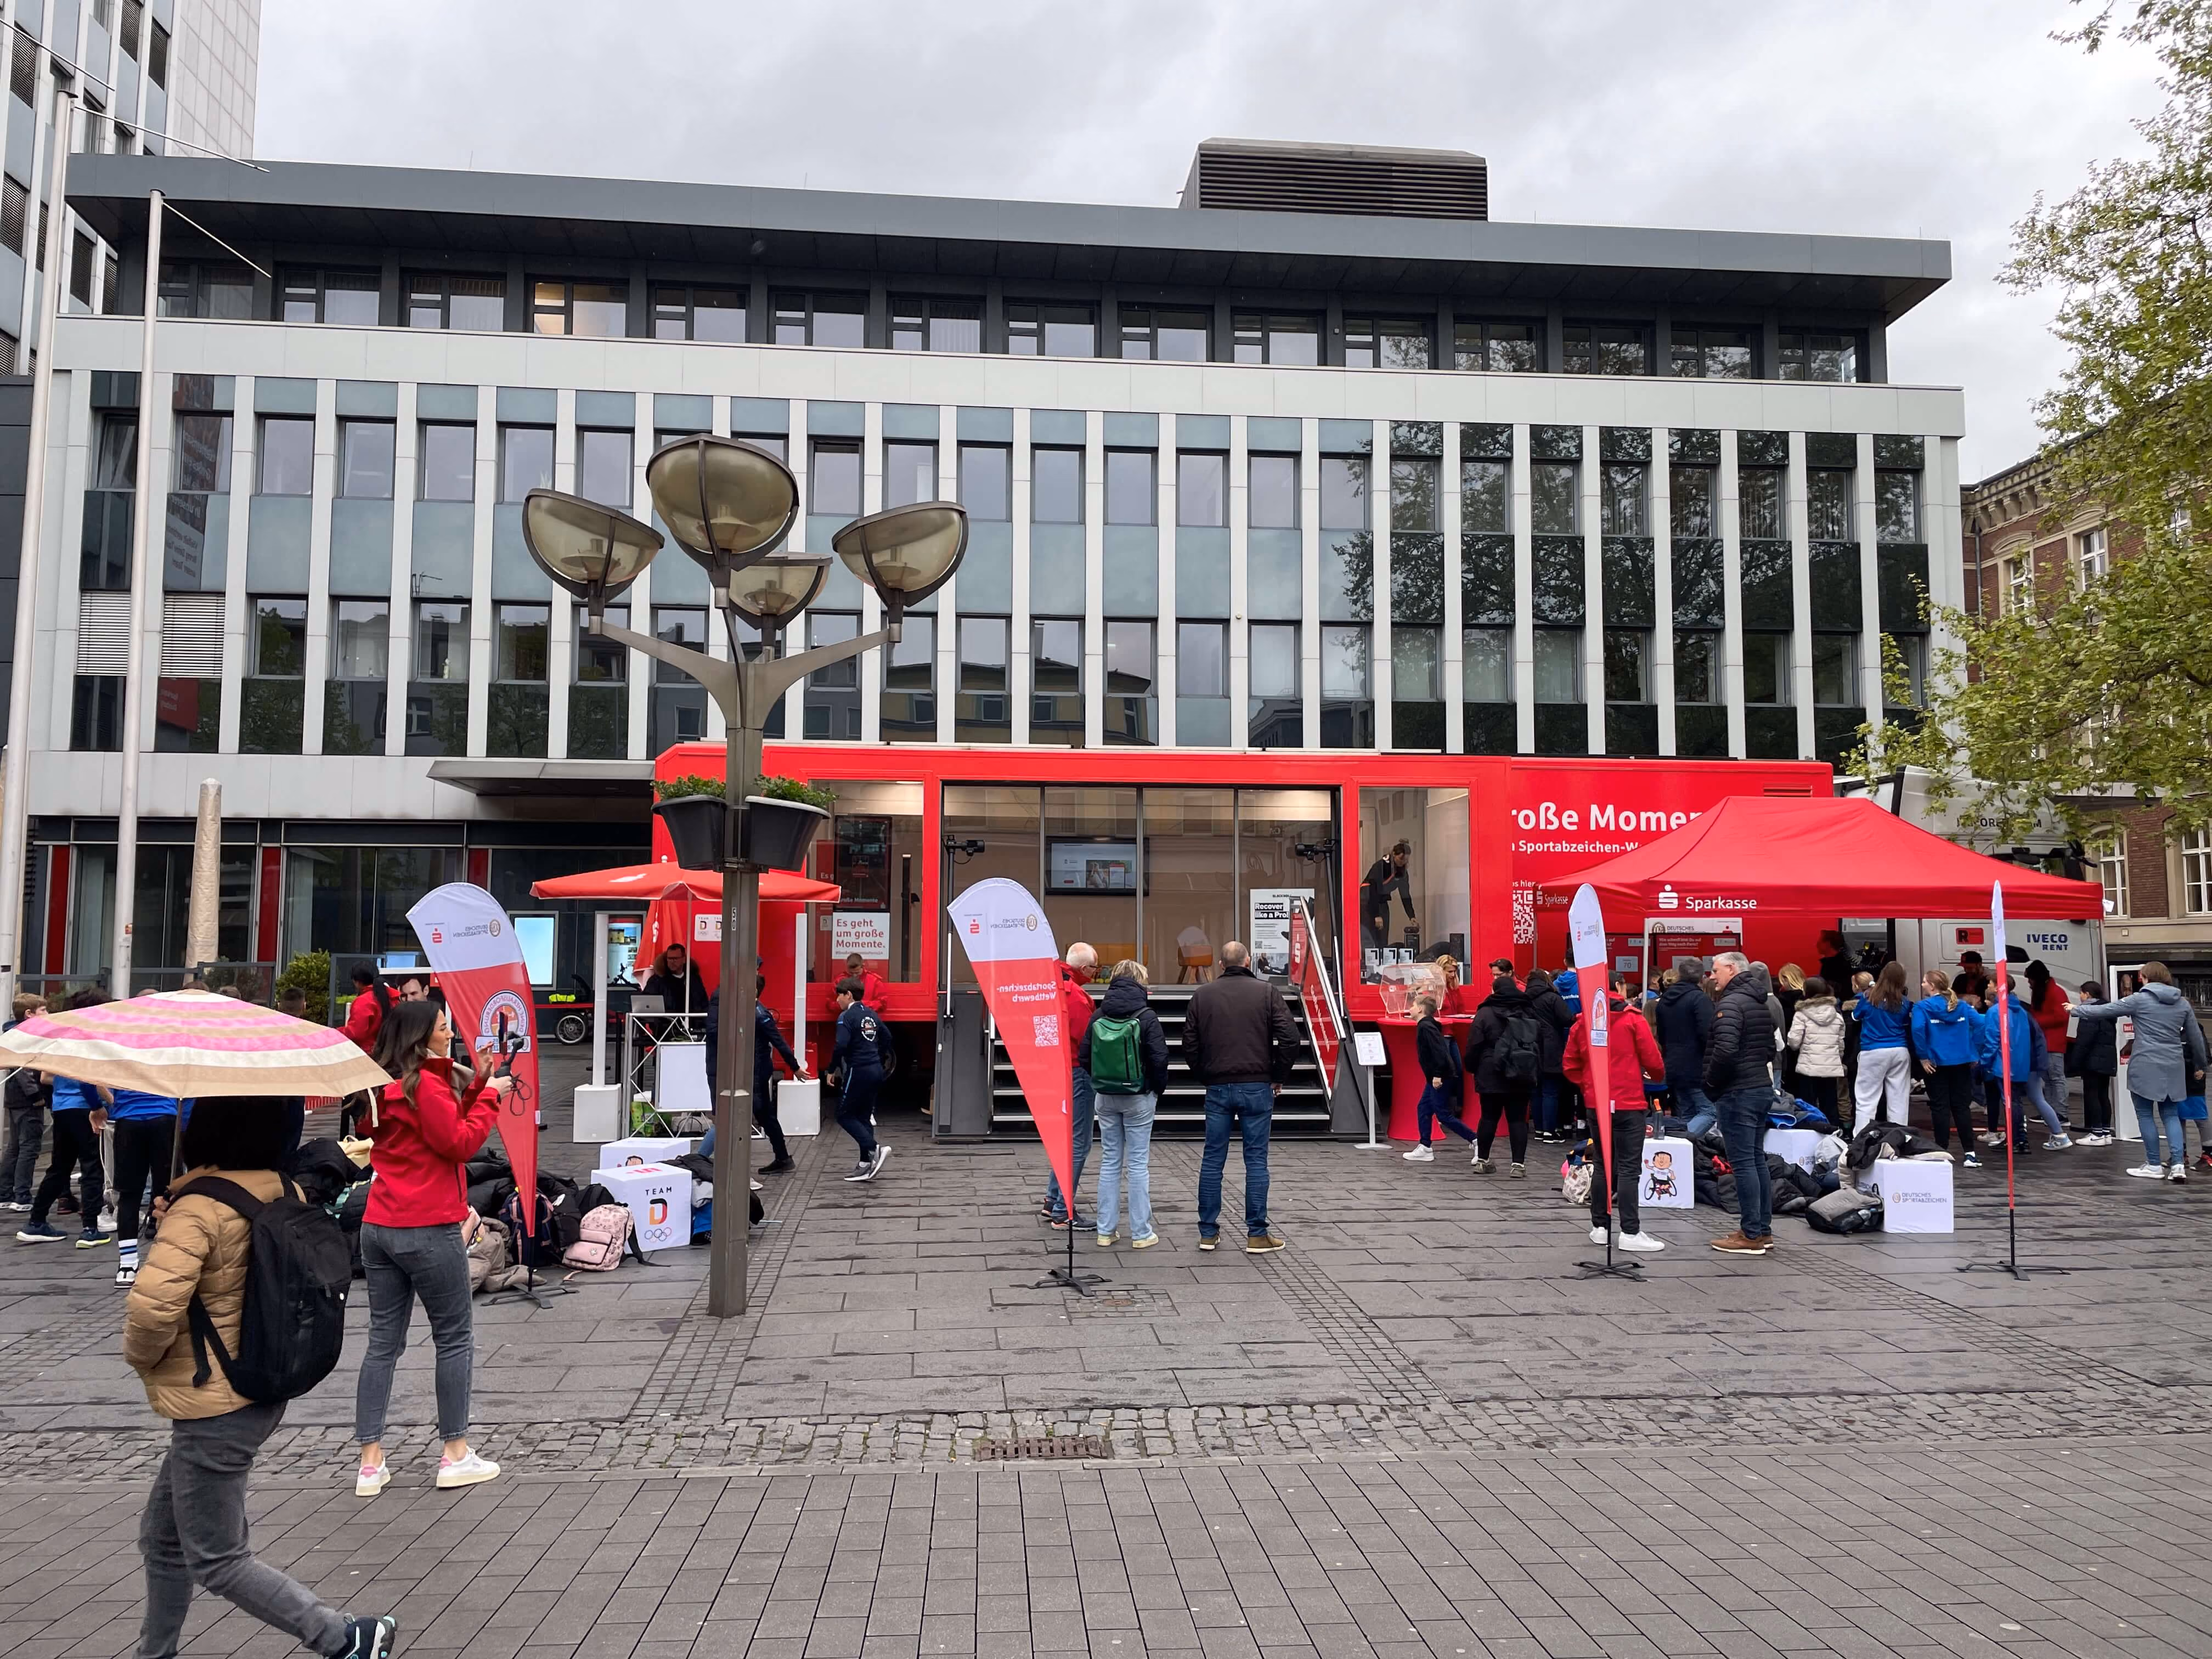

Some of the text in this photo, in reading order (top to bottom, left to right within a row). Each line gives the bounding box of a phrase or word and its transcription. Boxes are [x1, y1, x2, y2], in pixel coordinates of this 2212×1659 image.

[1519, 840, 1641, 854] Sportabzeichen-W
[1544, 894, 1568, 907] Sparkasse
[1685, 896, 1757, 912] Sparkasse
[837, 918, 874, 929] Es geht
[854, 929, 884, 940] große
[1958, 930, 1969, 943] R
[2027, 934, 2068, 943] IVECO
[836, 940, 885, 949] Momente.
[645, 1186, 673, 1196] TEAM
[649, 1198, 668, 1225] D
